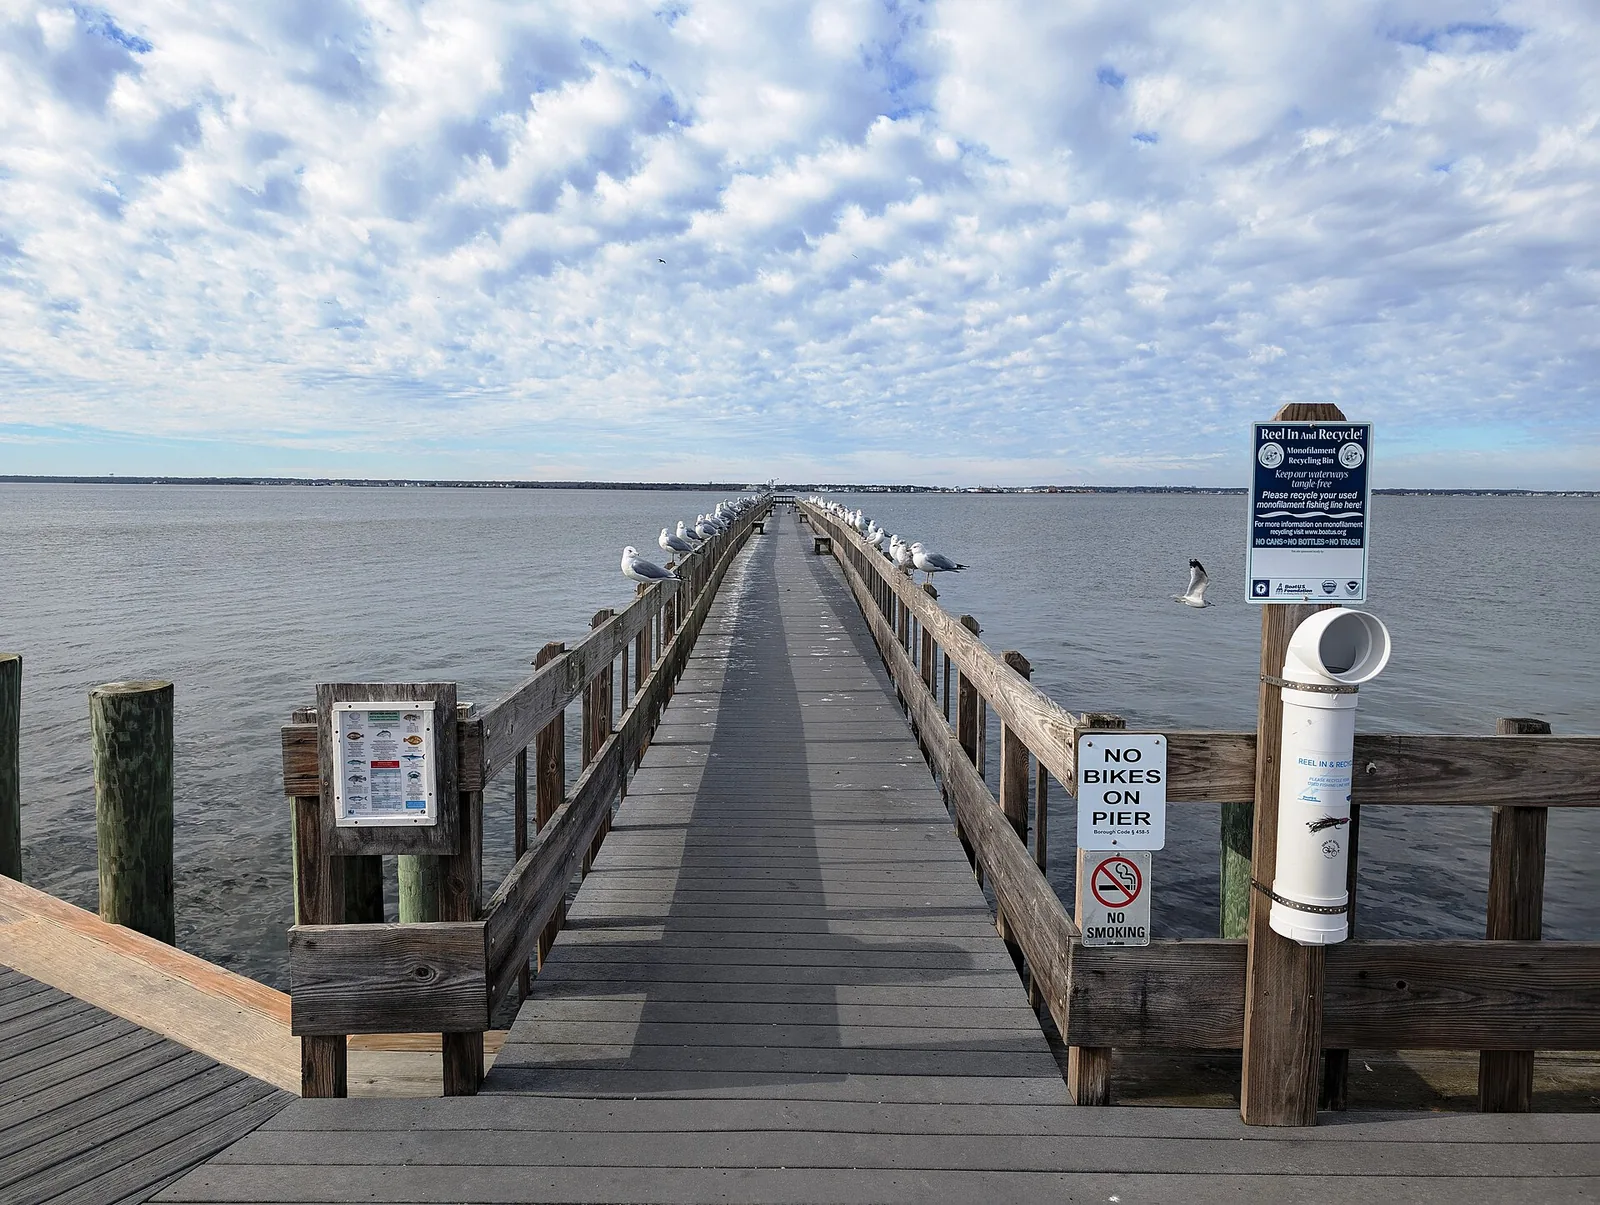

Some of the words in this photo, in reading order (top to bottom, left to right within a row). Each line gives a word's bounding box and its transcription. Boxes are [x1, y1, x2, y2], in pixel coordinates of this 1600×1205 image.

[1262, 428, 1285, 439] Reel
[1288, 429, 1299, 439] In
[1319, 428, 1362, 442] Recycle!
[1289, 457, 1321, 465] Recycling
[1276, 470, 1293, 479] Keep
[1309, 471, 1348, 480] waterways
[1292, 479, 1332, 489] tangle-free
[1262, 491, 1288, 499] Please
[1290, 491, 1317, 500] recycle
[1320, 492, 1336, 500] your
[1306, 501, 1329, 510] fishing
[1105, 749, 1142, 762] NO
[1299, 758, 1317, 766] REEL
[1084, 770, 1160, 783] BIKES
[1103, 791, 1140, 804] ON
[1092, 812, 1151, 826] PIER
[1107, 912, 1124, 923] NO
[1087, 926, 1145, 939] SMOKING
